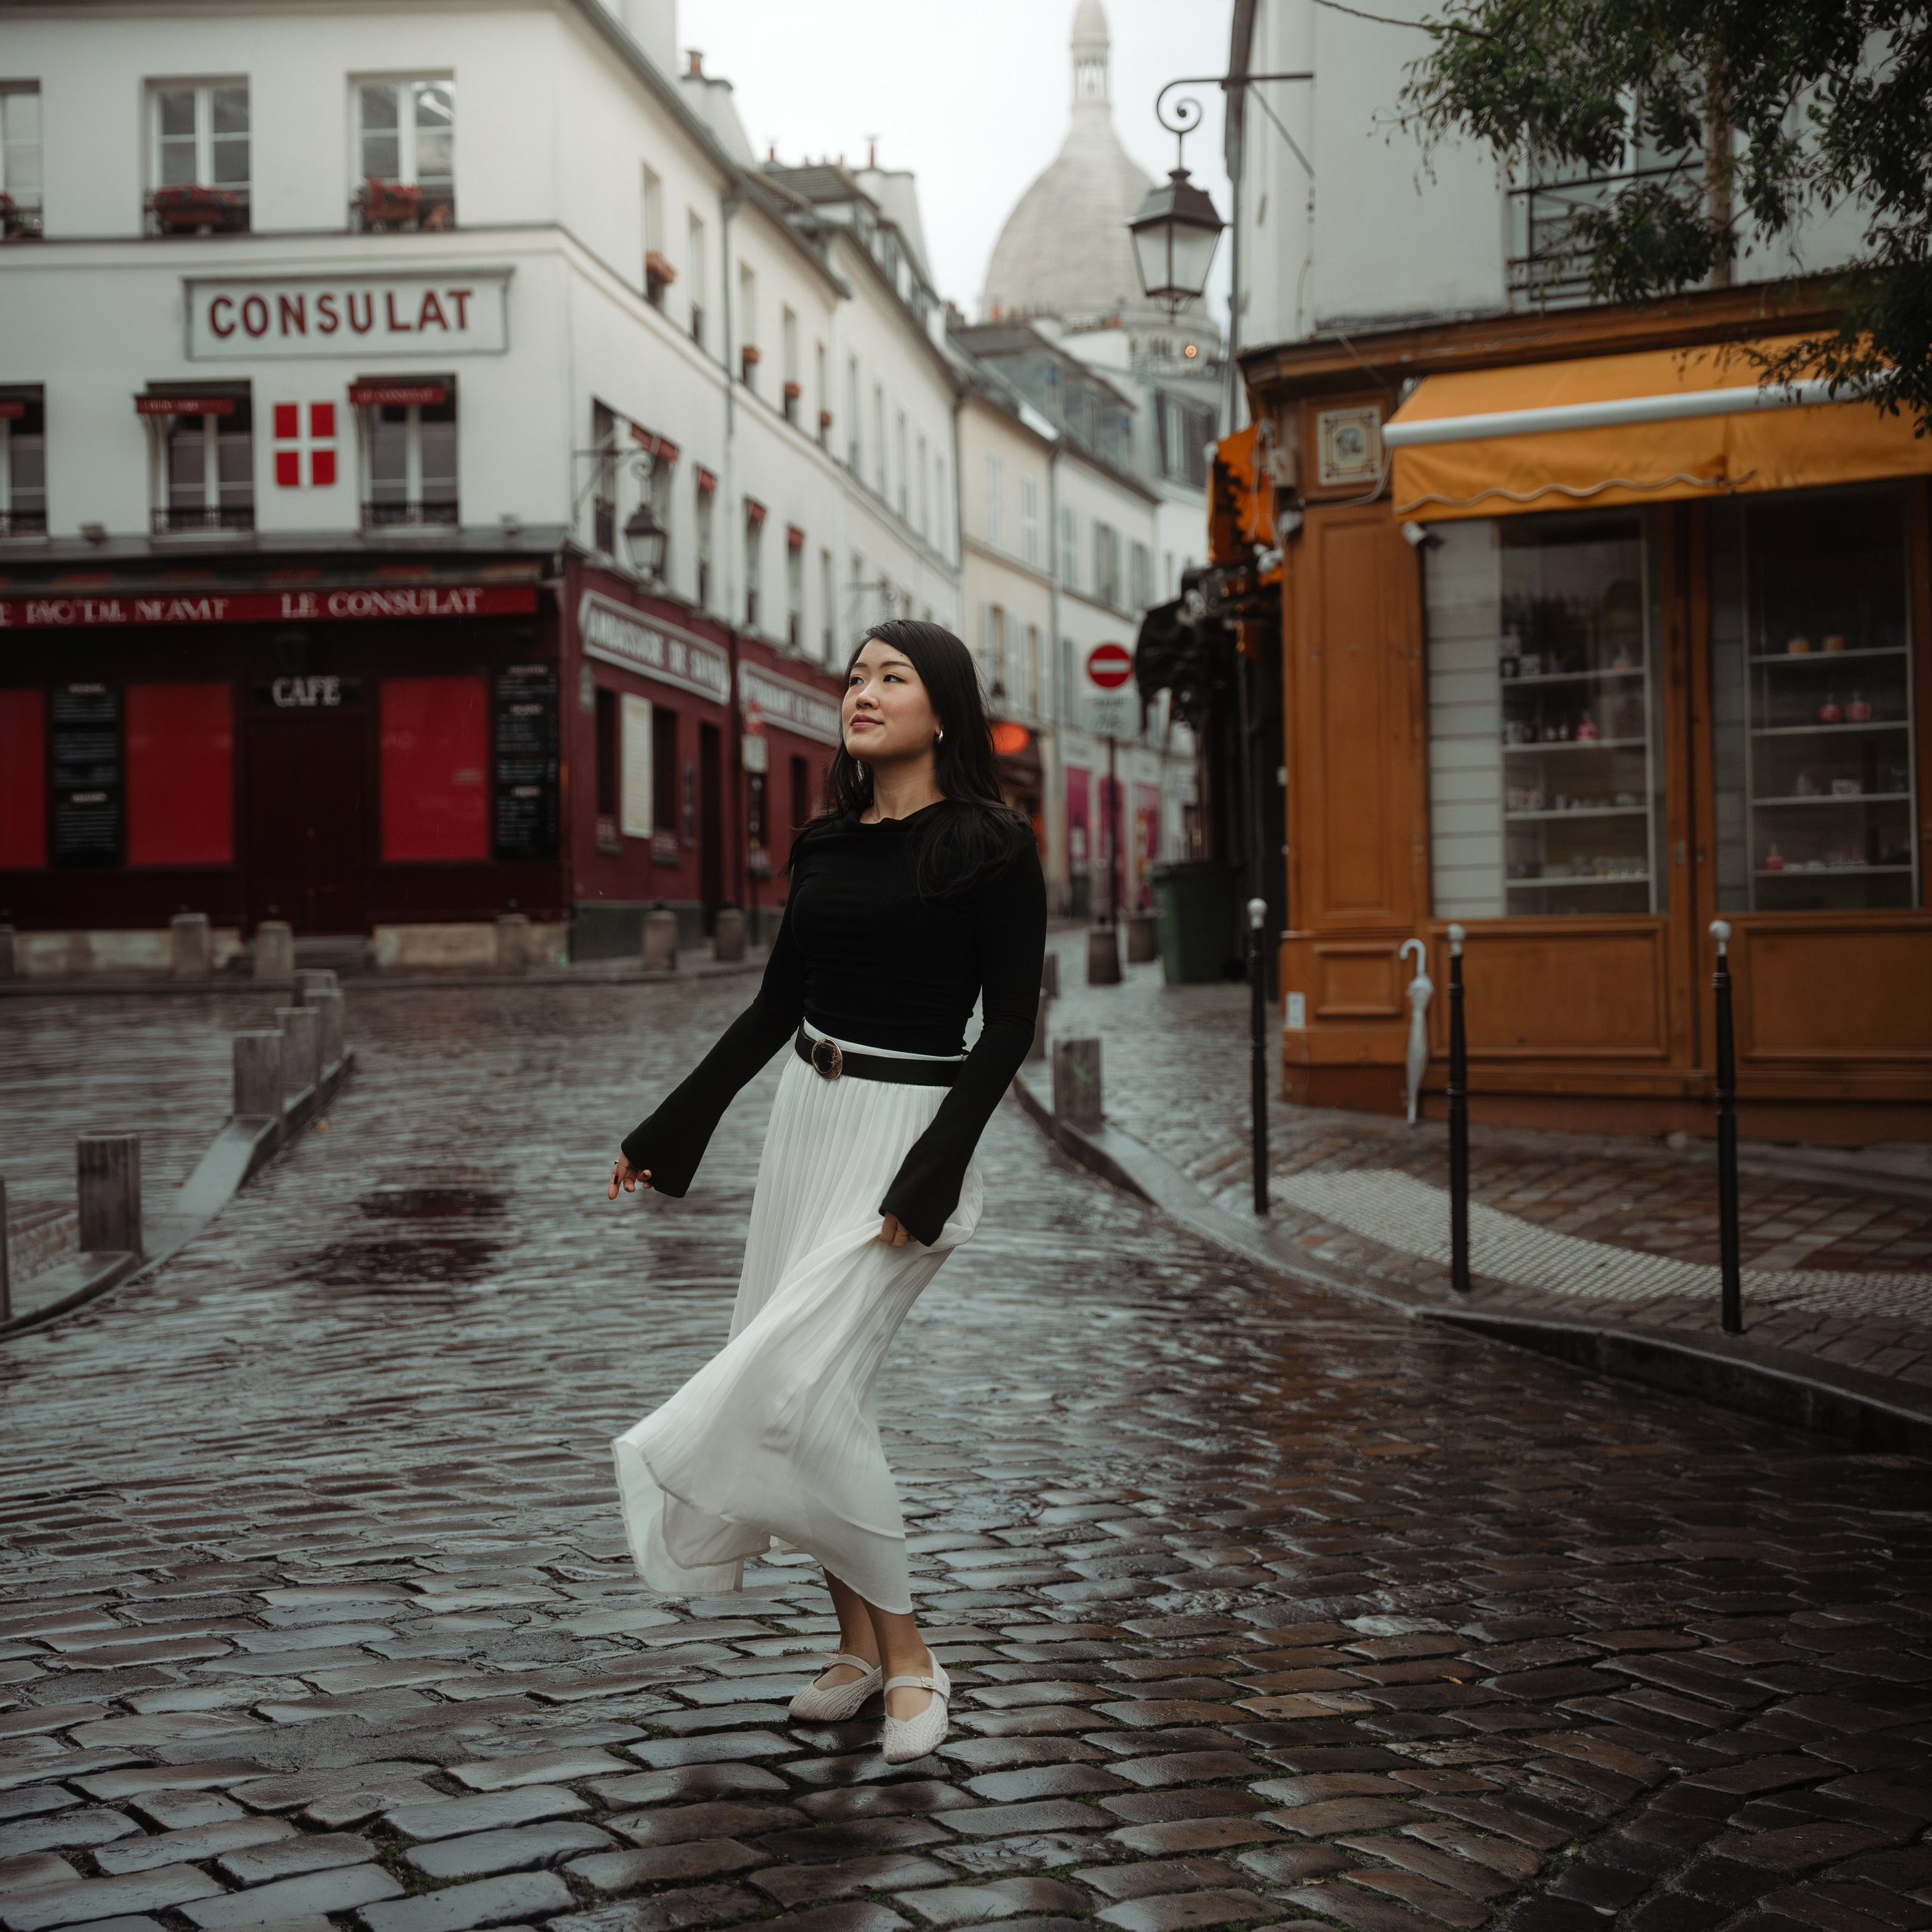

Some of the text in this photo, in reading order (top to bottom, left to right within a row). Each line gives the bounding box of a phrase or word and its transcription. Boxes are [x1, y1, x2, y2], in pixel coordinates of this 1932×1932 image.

[209, 289, 473, 339] CONSULAT
[281, 586, 484, 618] LE CONSULAT
[272, 675, 342, 708] CAFE
